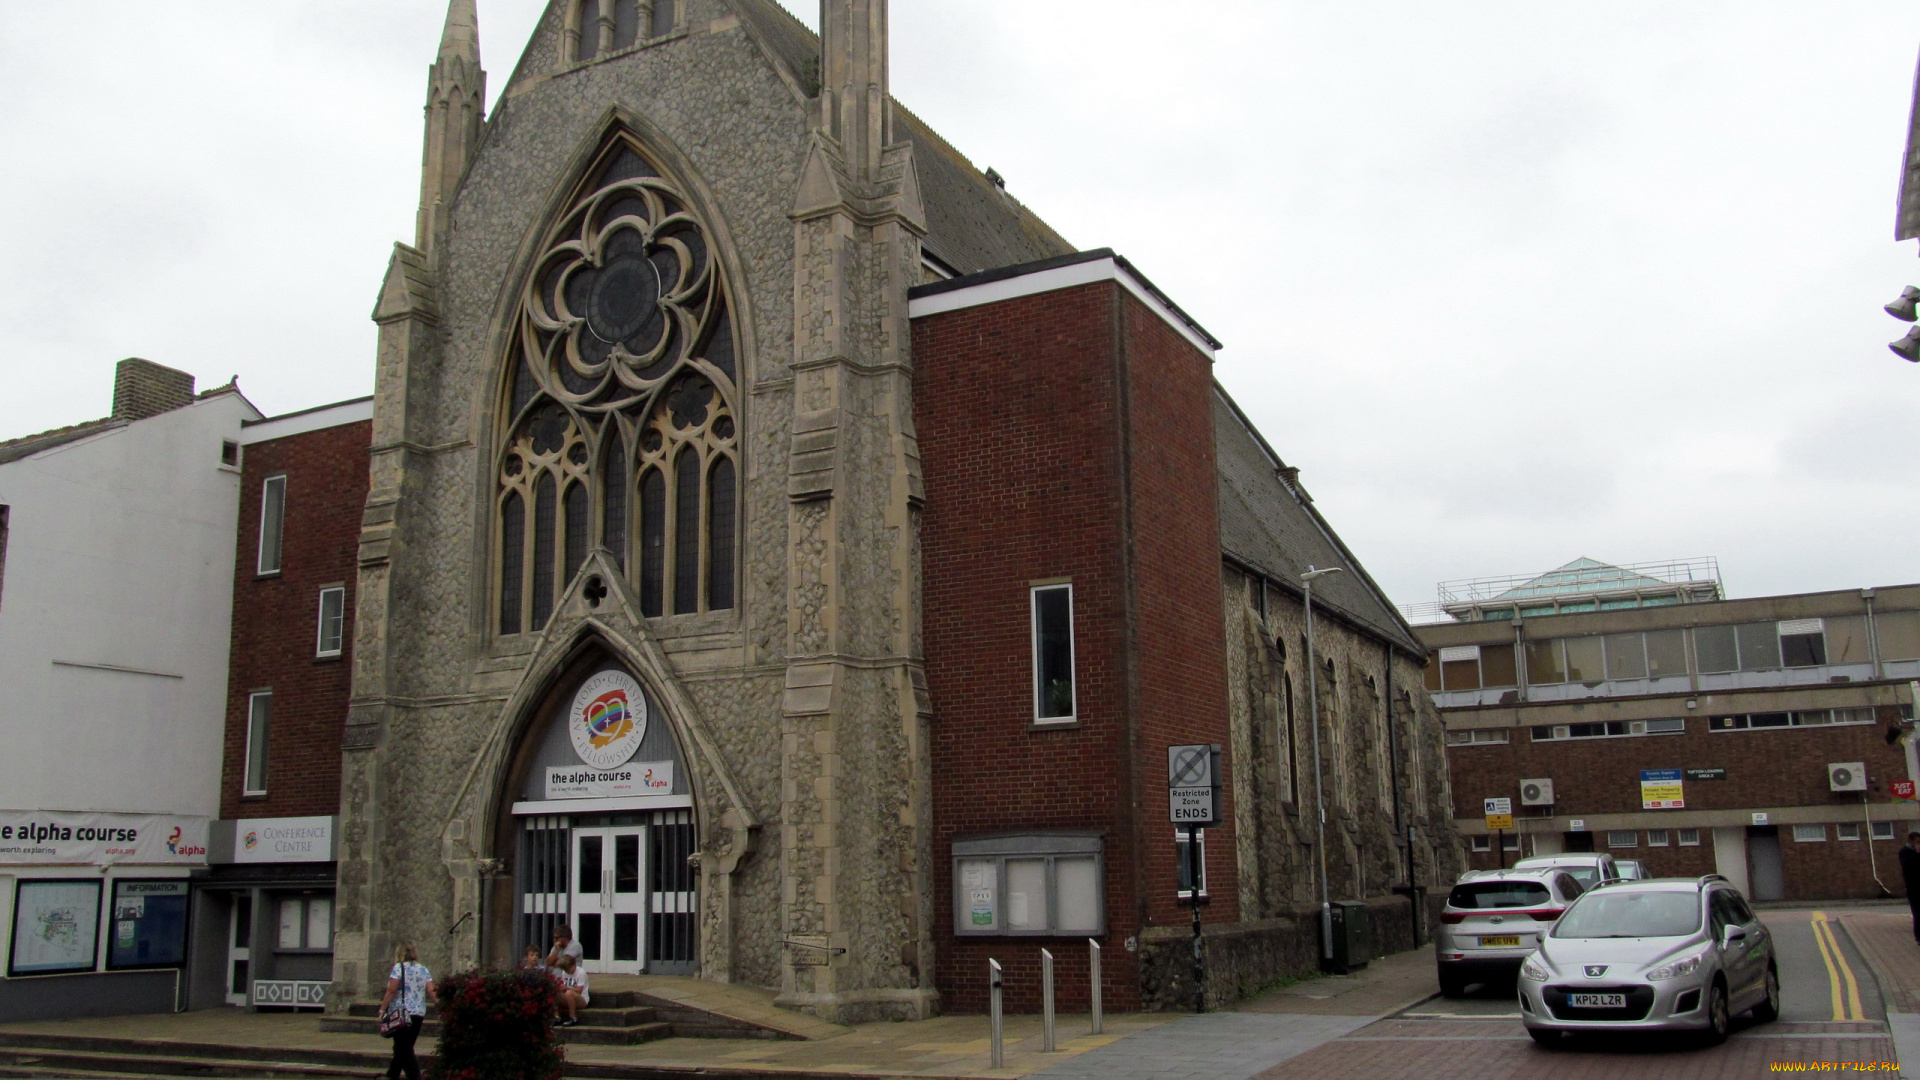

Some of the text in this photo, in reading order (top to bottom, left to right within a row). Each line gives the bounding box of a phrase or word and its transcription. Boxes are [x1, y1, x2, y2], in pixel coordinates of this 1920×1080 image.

[573, 673, 643, 731] ASHFORD CHRISTIAN
[578, 736, 637, 765] FELLOWSHIP
[551, 771, 632, 785] the alpha course
[651, 780, 668, 788] alpha
[1893, 782, 1911, 790] JUST
[1175, 808, 1208, 818] ENDS
[17, 822, 72, 844] alpha
[76, 826, 138, 842] course
[263, 827, 326, 840] CONFERENCE
[23, 846, 57, 856] exploring
[104, 847, 137, 856] alpha.org
[178, 845, 206, 857] alpha
[274, 840, 313, 853] CENTRE
[125, 883, 179, 893] INFORMATION
[1575, 995, 1622, 1005] KP12 LZR
